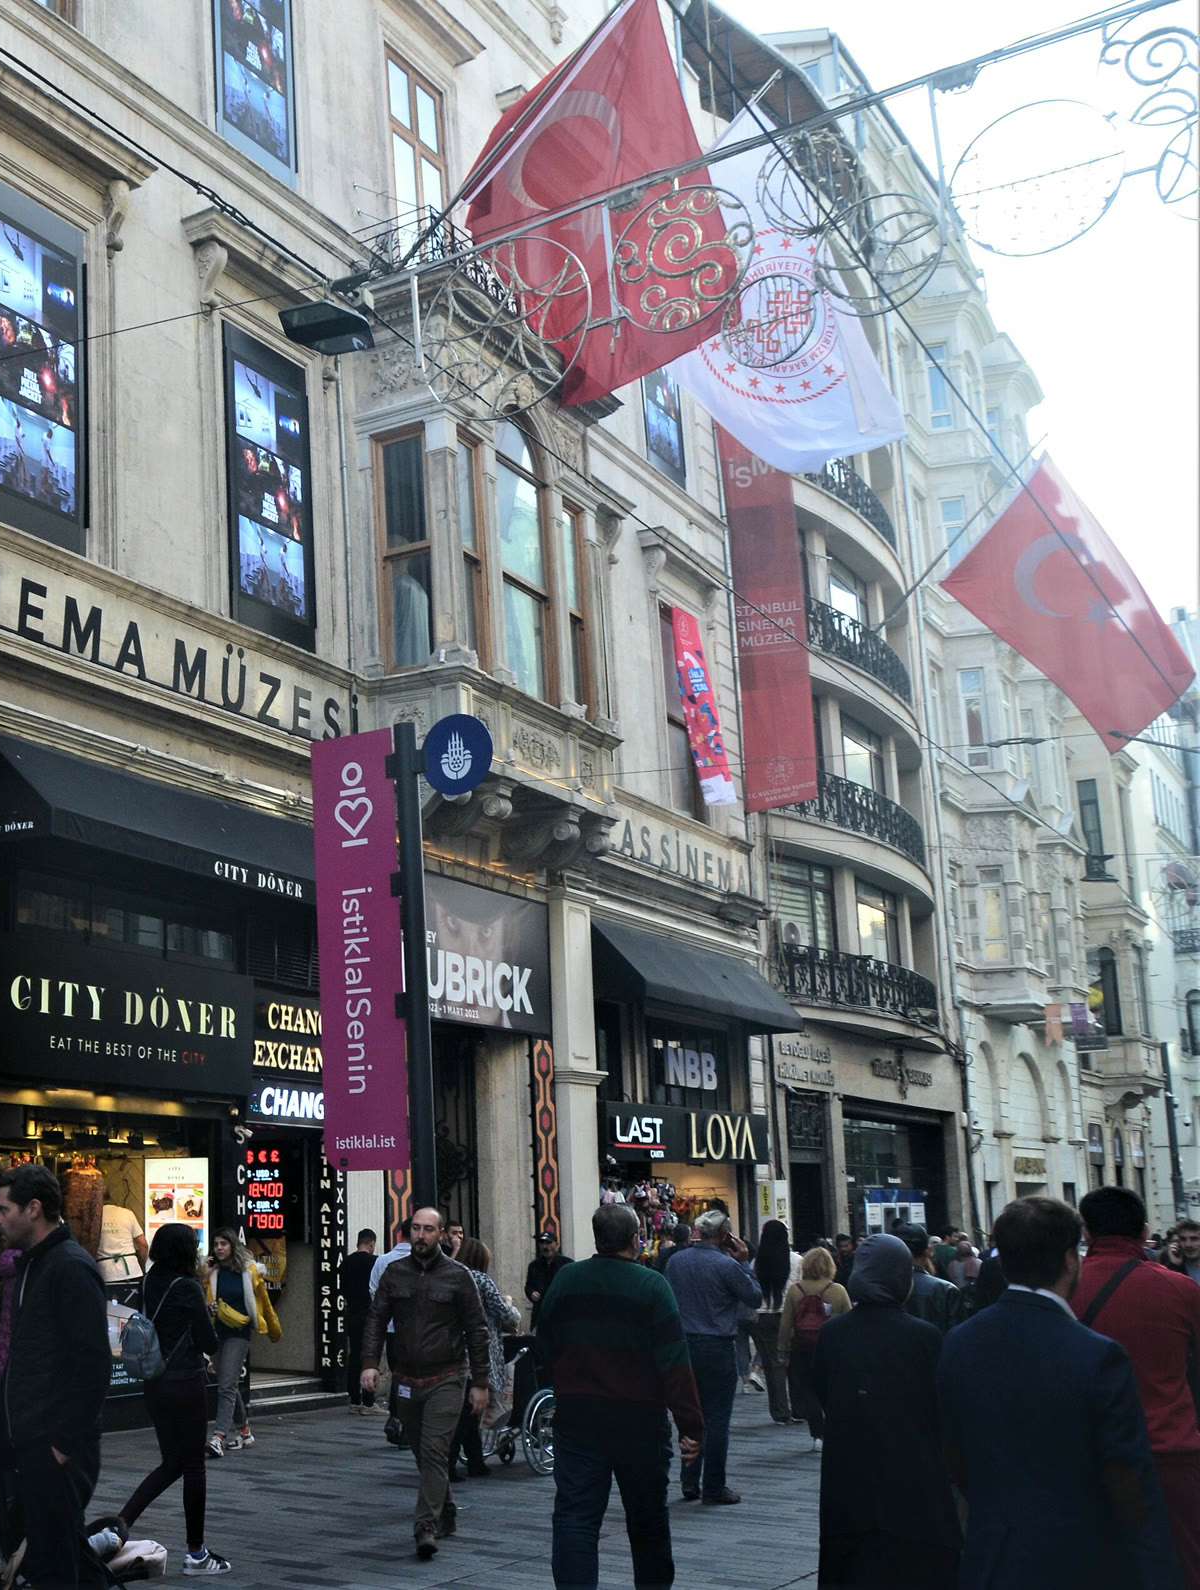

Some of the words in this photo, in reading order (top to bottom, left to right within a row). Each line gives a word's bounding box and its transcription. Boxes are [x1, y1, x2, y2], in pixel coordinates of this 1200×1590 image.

[736, 601, 802, 617] STANBUL
[171, 637, 360, 741] MÜZESİ
[4, 820, 34, 833] DÖNER
[213, 859, 250, 884] CITY
[257, 871, 303, 899] DÖNER
[401, 942, 535, 1015] UBRICK
[10, 974, 106, 1021] CITY
[123, 986, 238, 1039] DÖNER
[267, 1002, 322, 1036] CHAN
[448, 1006, 464, 1016] MART
[465, 1009, 479, 1019] 2023
[50, 1035, 72, 1050] EAT
[78, 1038, 100, 1054] THE
[105, 1042, 133, 1057] BEST
[137, 1046, 153, 1059] OF
[158, 1048, 177, 1063] THE
[182, 1050, 207, 1065] CITY
[665, 1045, 717, 1091] NBB
[335, 1134, 396, 1151] istiklal.ist
[615, 1114, 663, 1144] LAST
[690, 1112, 758, 1160] LOYA
[319, 1202, 332, 1272] ALINIR
[320, 1285, 332, 1368] SATILIR
